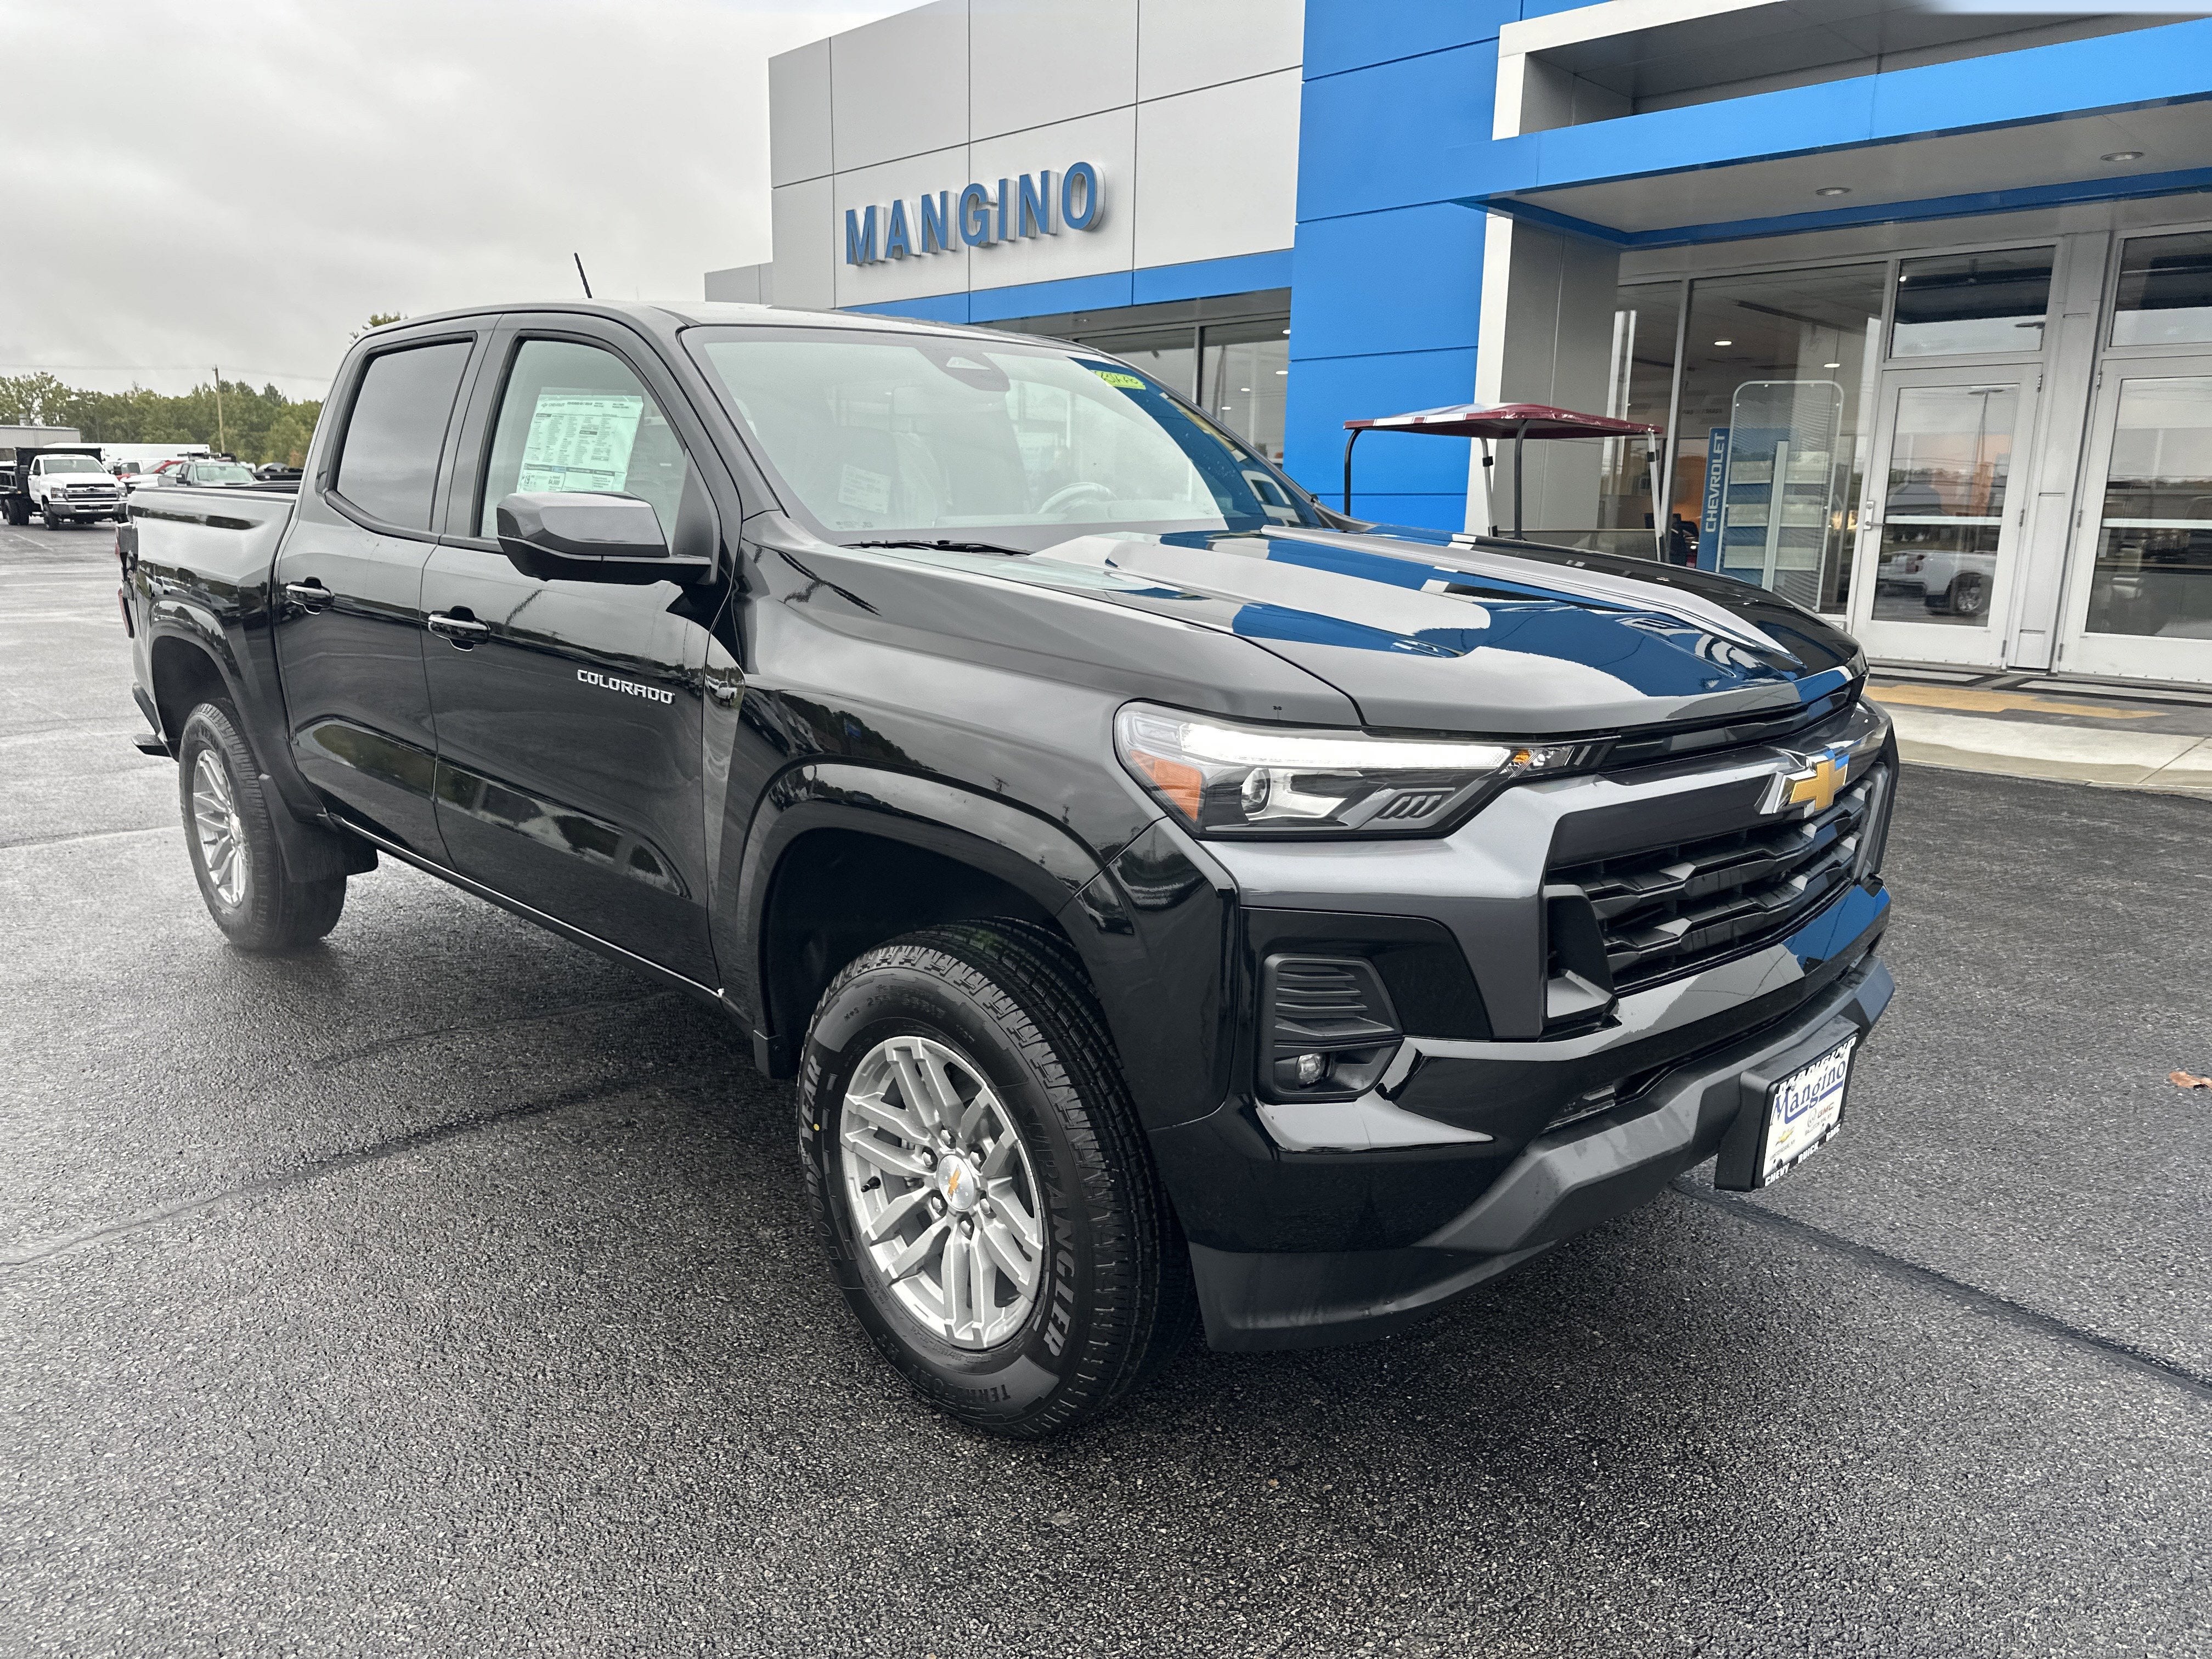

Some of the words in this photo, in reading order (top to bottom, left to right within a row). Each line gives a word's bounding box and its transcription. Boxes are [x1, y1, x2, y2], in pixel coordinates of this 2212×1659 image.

[845, 161, 1105, 266] MANGINO
[1705, 433, 1725, 533] CHEVROLET
[577, 669, 674, 704] COLORADO
[1769, 1059, 1847, 1126] Mangino
[1818, 1102, 1835, 1119] GMC
[1764, 1163, 1790, 1187] CHEVY
[1797, 1141, 1819, 1164] BUICK
[1825, 1123, 1841, 1142] GMC
[1022, 1106, 1075, 1357] WRANGLER
